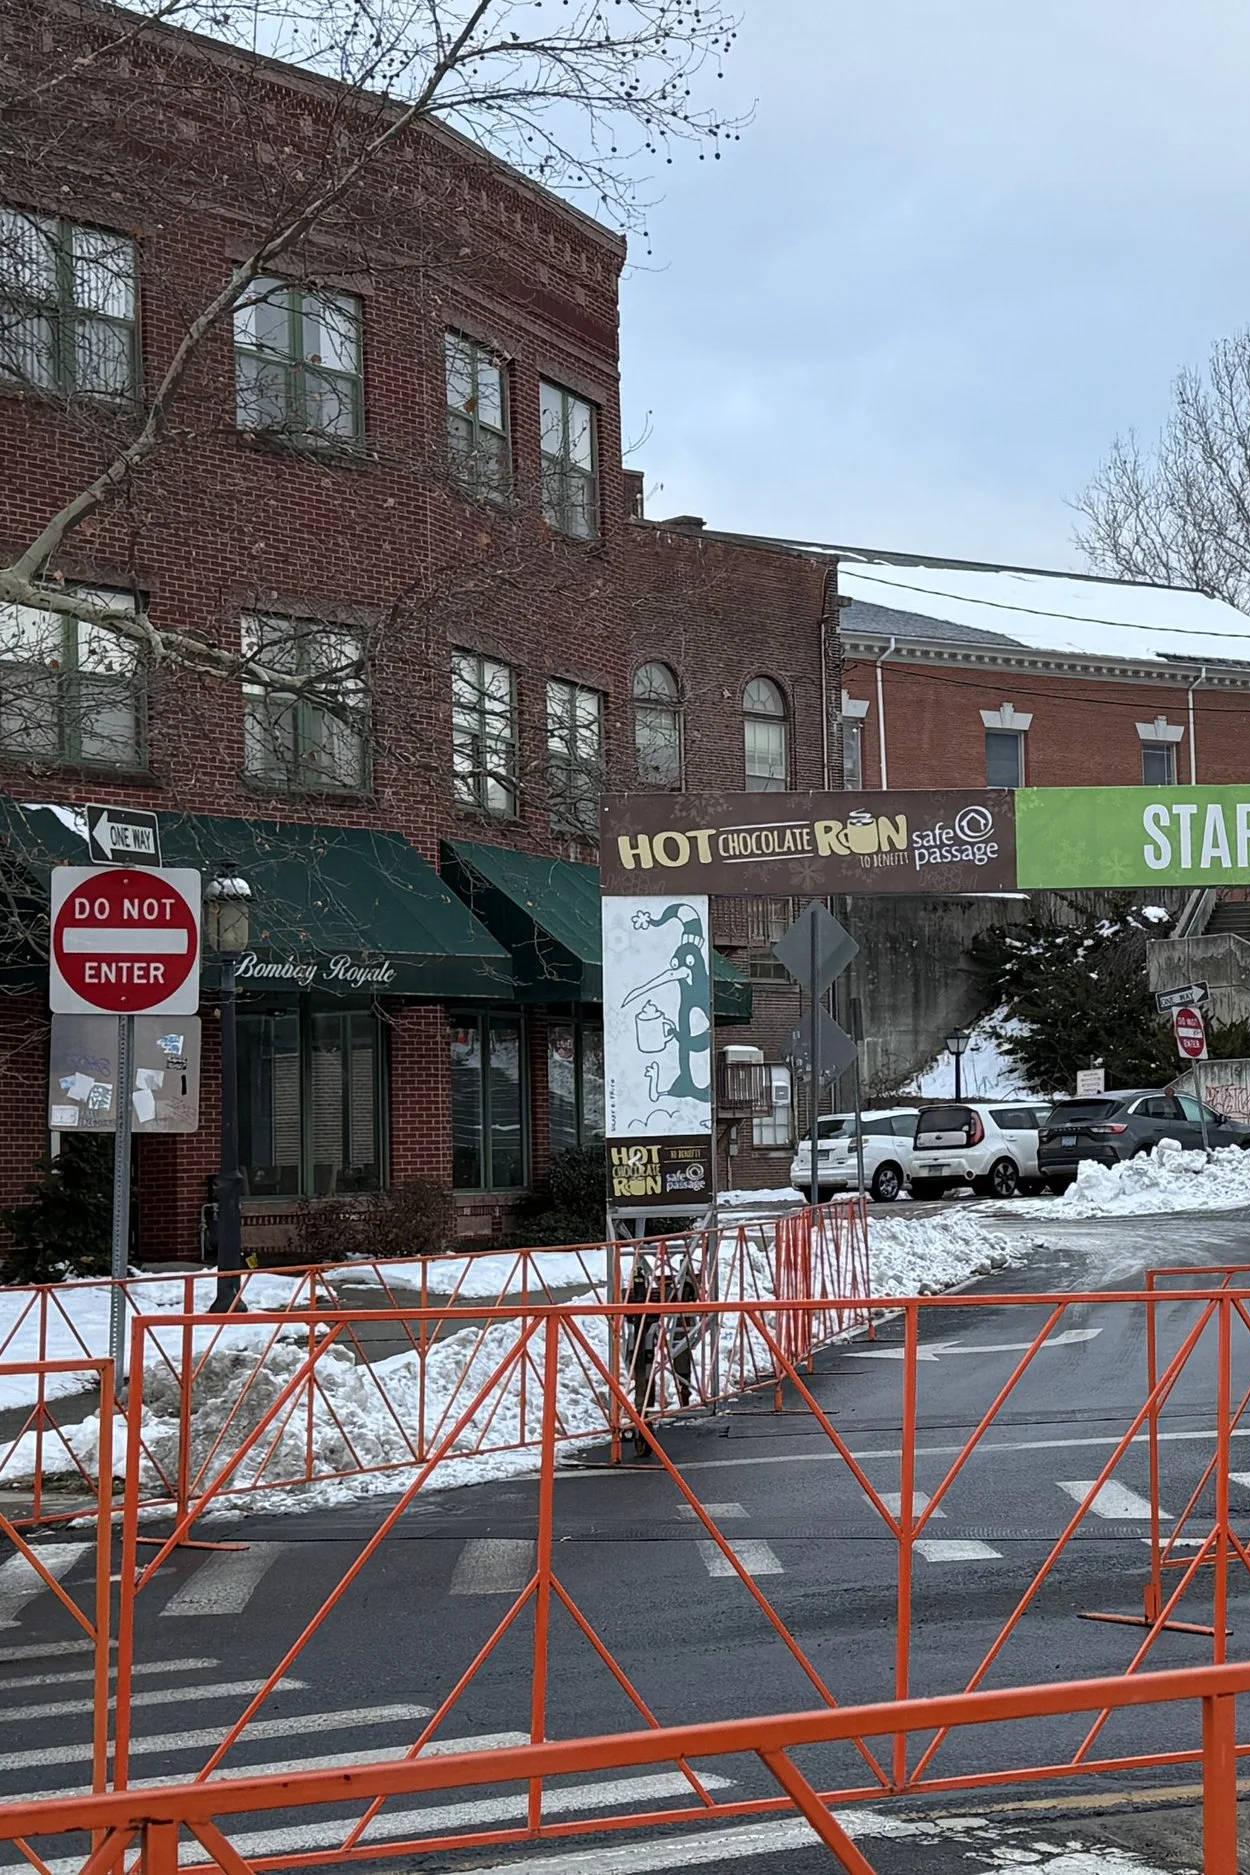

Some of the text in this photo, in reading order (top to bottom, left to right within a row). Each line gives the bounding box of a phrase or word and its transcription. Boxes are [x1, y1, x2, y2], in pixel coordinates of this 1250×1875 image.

[110, 825, 151, 851] ONE WAY
[912, 822, 954, 847] safe
[617, 829, 717, 869] HOT
[718, 828, 811, 856] CHOCOLATE
[859, 850, 909, 868] TO BENEFIT
[914, 842, 999, 871] passage
[74, 898, 175, 920] DO NOT
[84, 962, 165, 984] ENTER
[233, 951, 397, 988] Bombay Royale
[611, 1145, 662, 1166] HOT
[666, 1170, 686, 1182] safe
[666, 1180, 706, 1192] passage
